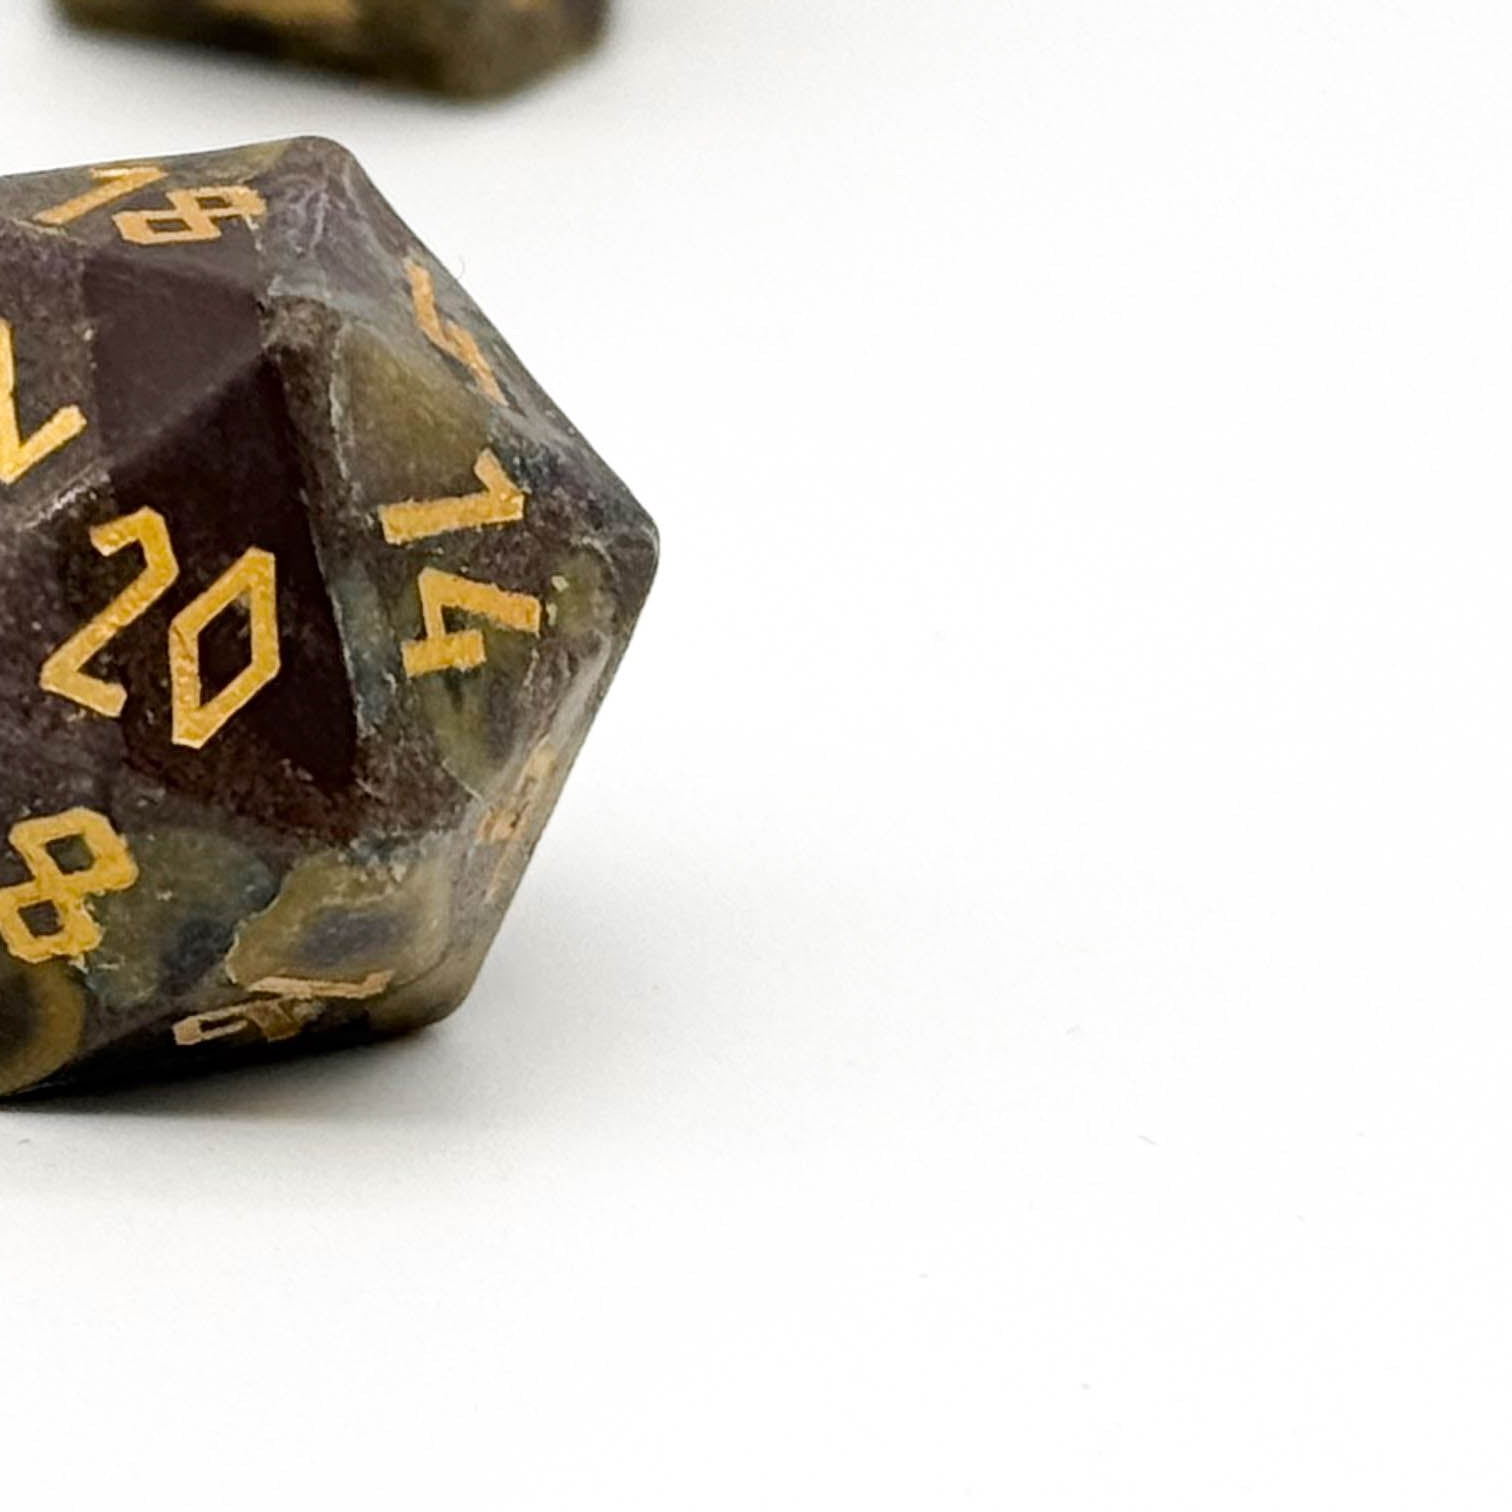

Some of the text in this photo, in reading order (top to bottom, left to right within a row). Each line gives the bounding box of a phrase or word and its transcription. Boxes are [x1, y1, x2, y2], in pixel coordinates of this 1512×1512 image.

[33, 164, 266, 246] 18
[40, 506, 281, 749] 20
[378, 448, 541, 678] 14
